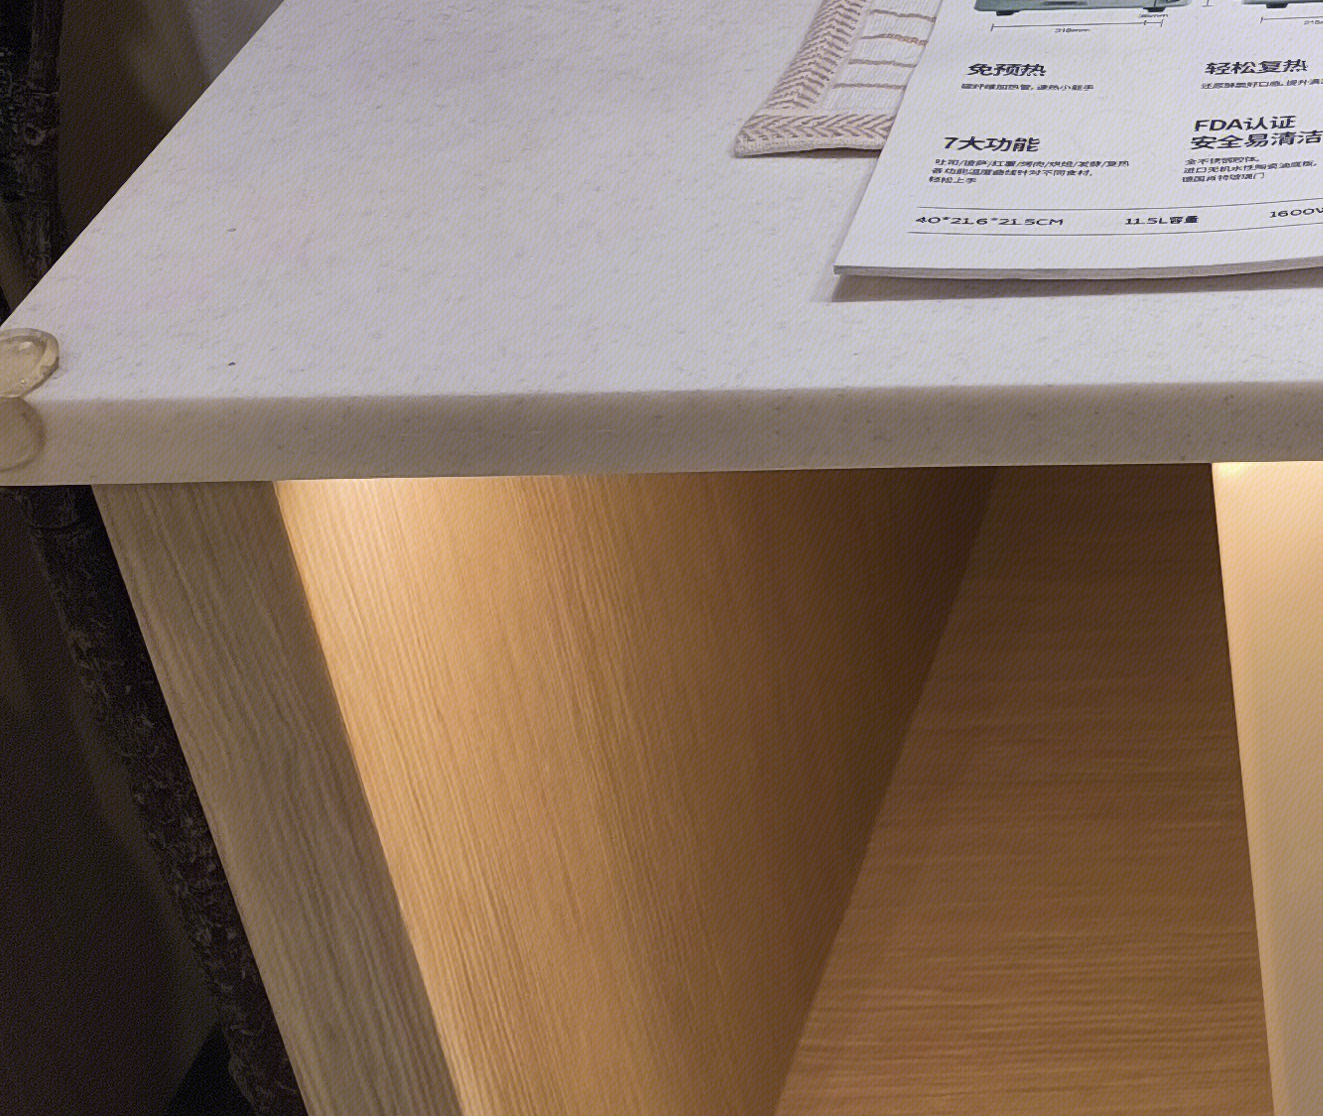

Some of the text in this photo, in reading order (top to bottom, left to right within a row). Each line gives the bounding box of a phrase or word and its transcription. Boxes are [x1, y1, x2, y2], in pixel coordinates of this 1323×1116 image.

[967, 62, 1047, 79] 免预热
[1205, 58, 1309, 77] 轻松复热
[1194, 115, 1297, 133] FDA认证
[943, 134, 1042, 154] 7大功能
[1124, 214, 1200, 226] 11.5L容量
